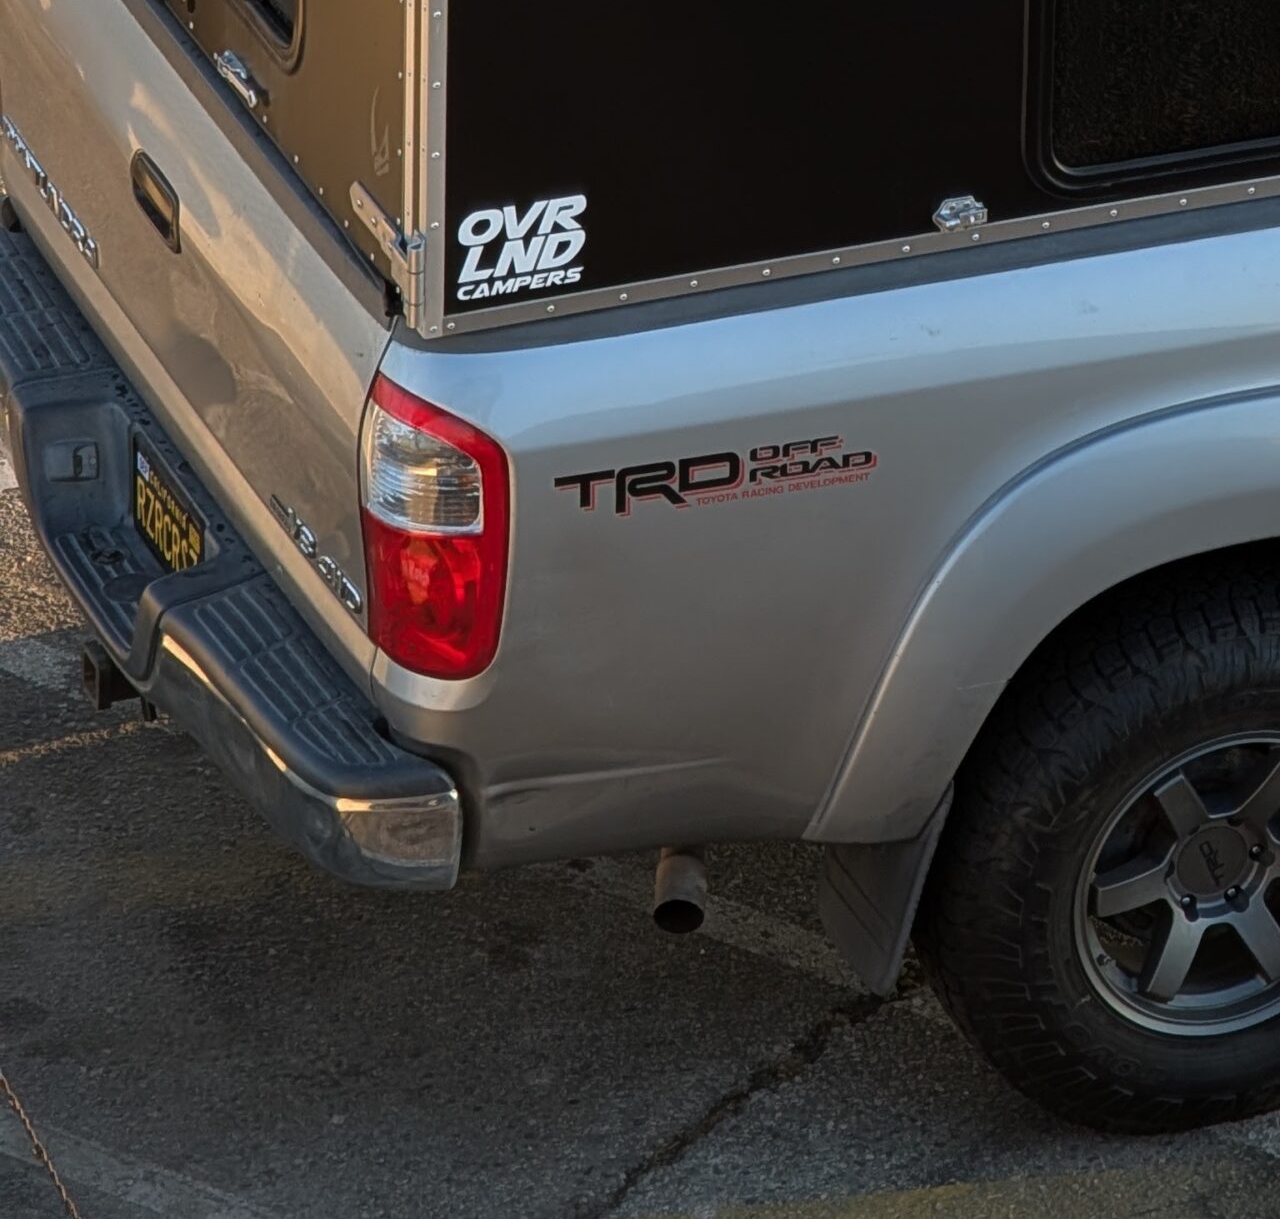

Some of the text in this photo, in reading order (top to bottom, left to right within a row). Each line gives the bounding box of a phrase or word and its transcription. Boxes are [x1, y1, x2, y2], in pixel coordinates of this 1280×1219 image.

[457, 194, 588, 247] OVR
[457, 228, 587, 284] LND
[456, 266, 585, 301] CAMPERS
[749, 435, 844, 466] OFF
[749, 450, 878, 486] ROAD
[554, 452, 746, 517] TRD
[695, 472, 872, 507] TOYOTA RACING DEVELOPMENT
[1199, 841, 1225, 888] TRD
